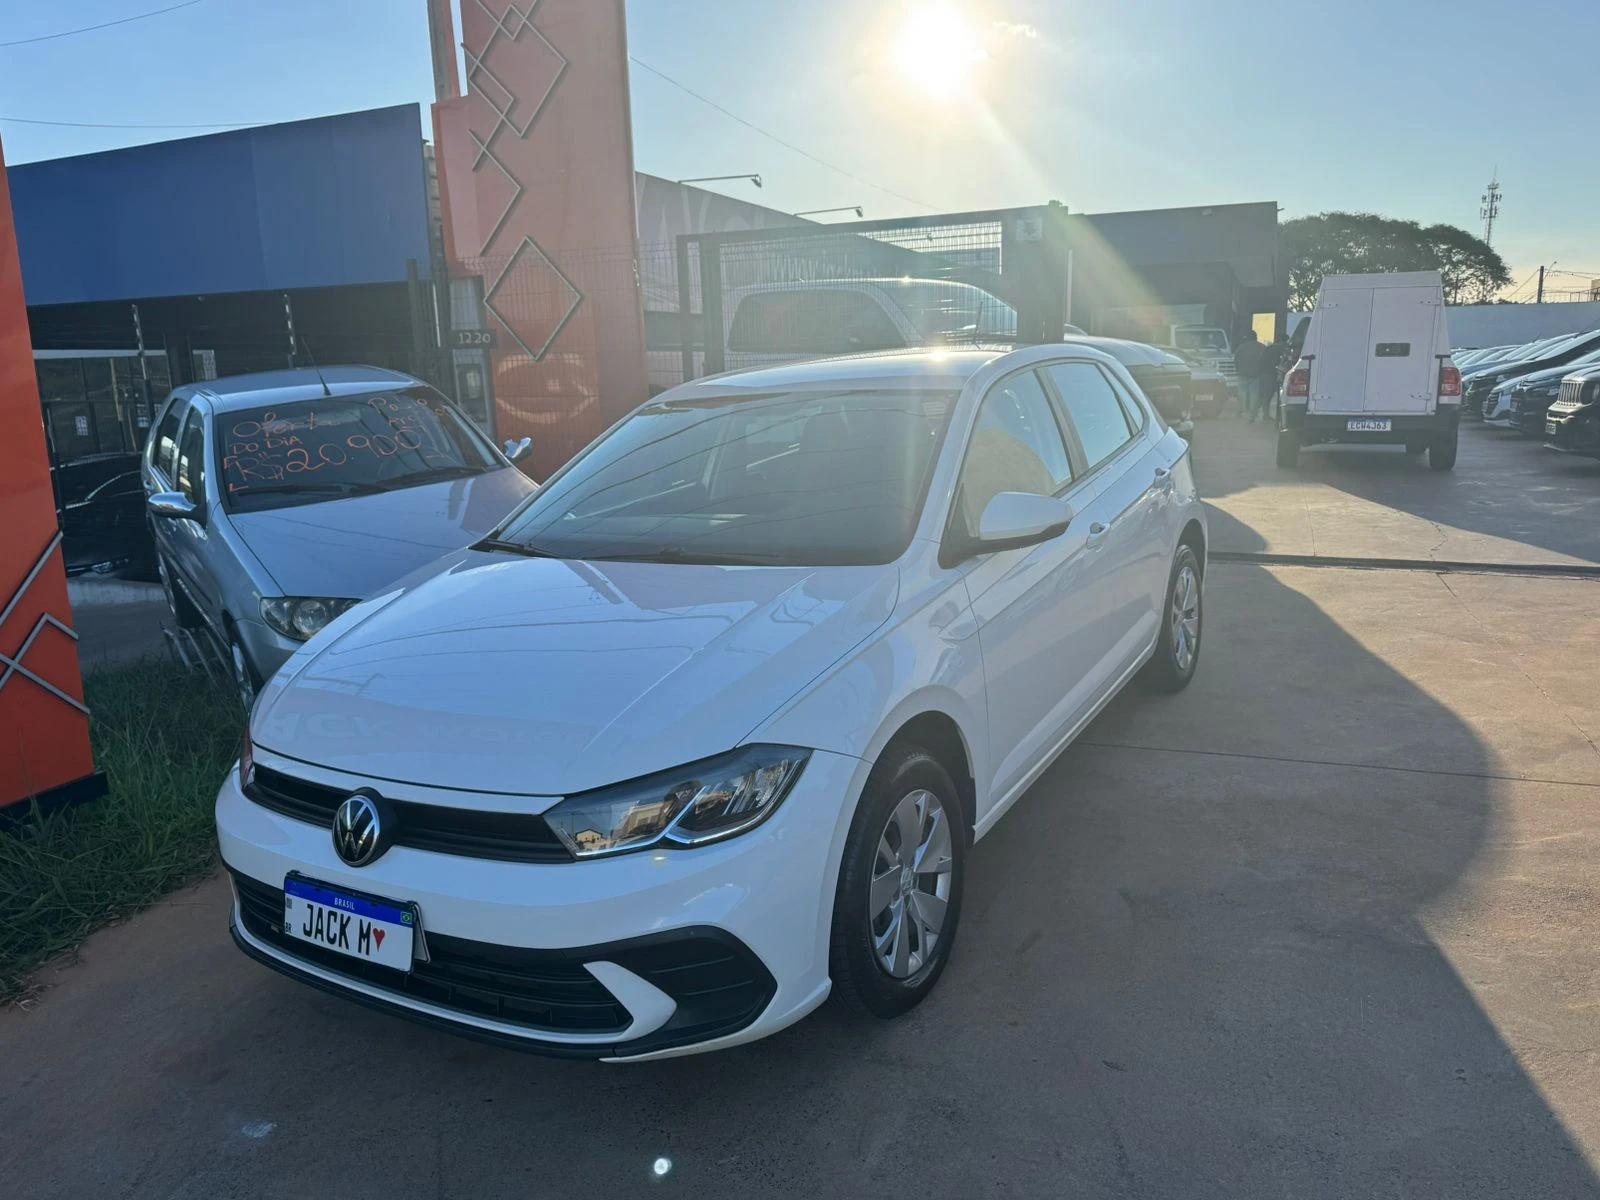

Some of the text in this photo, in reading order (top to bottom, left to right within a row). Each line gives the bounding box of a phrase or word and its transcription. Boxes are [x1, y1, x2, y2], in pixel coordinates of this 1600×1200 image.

[459, 332, 491, 344] 1220
[334, 897, 355, 911] BRASIL
[303, 903, 351, 949] JACK
